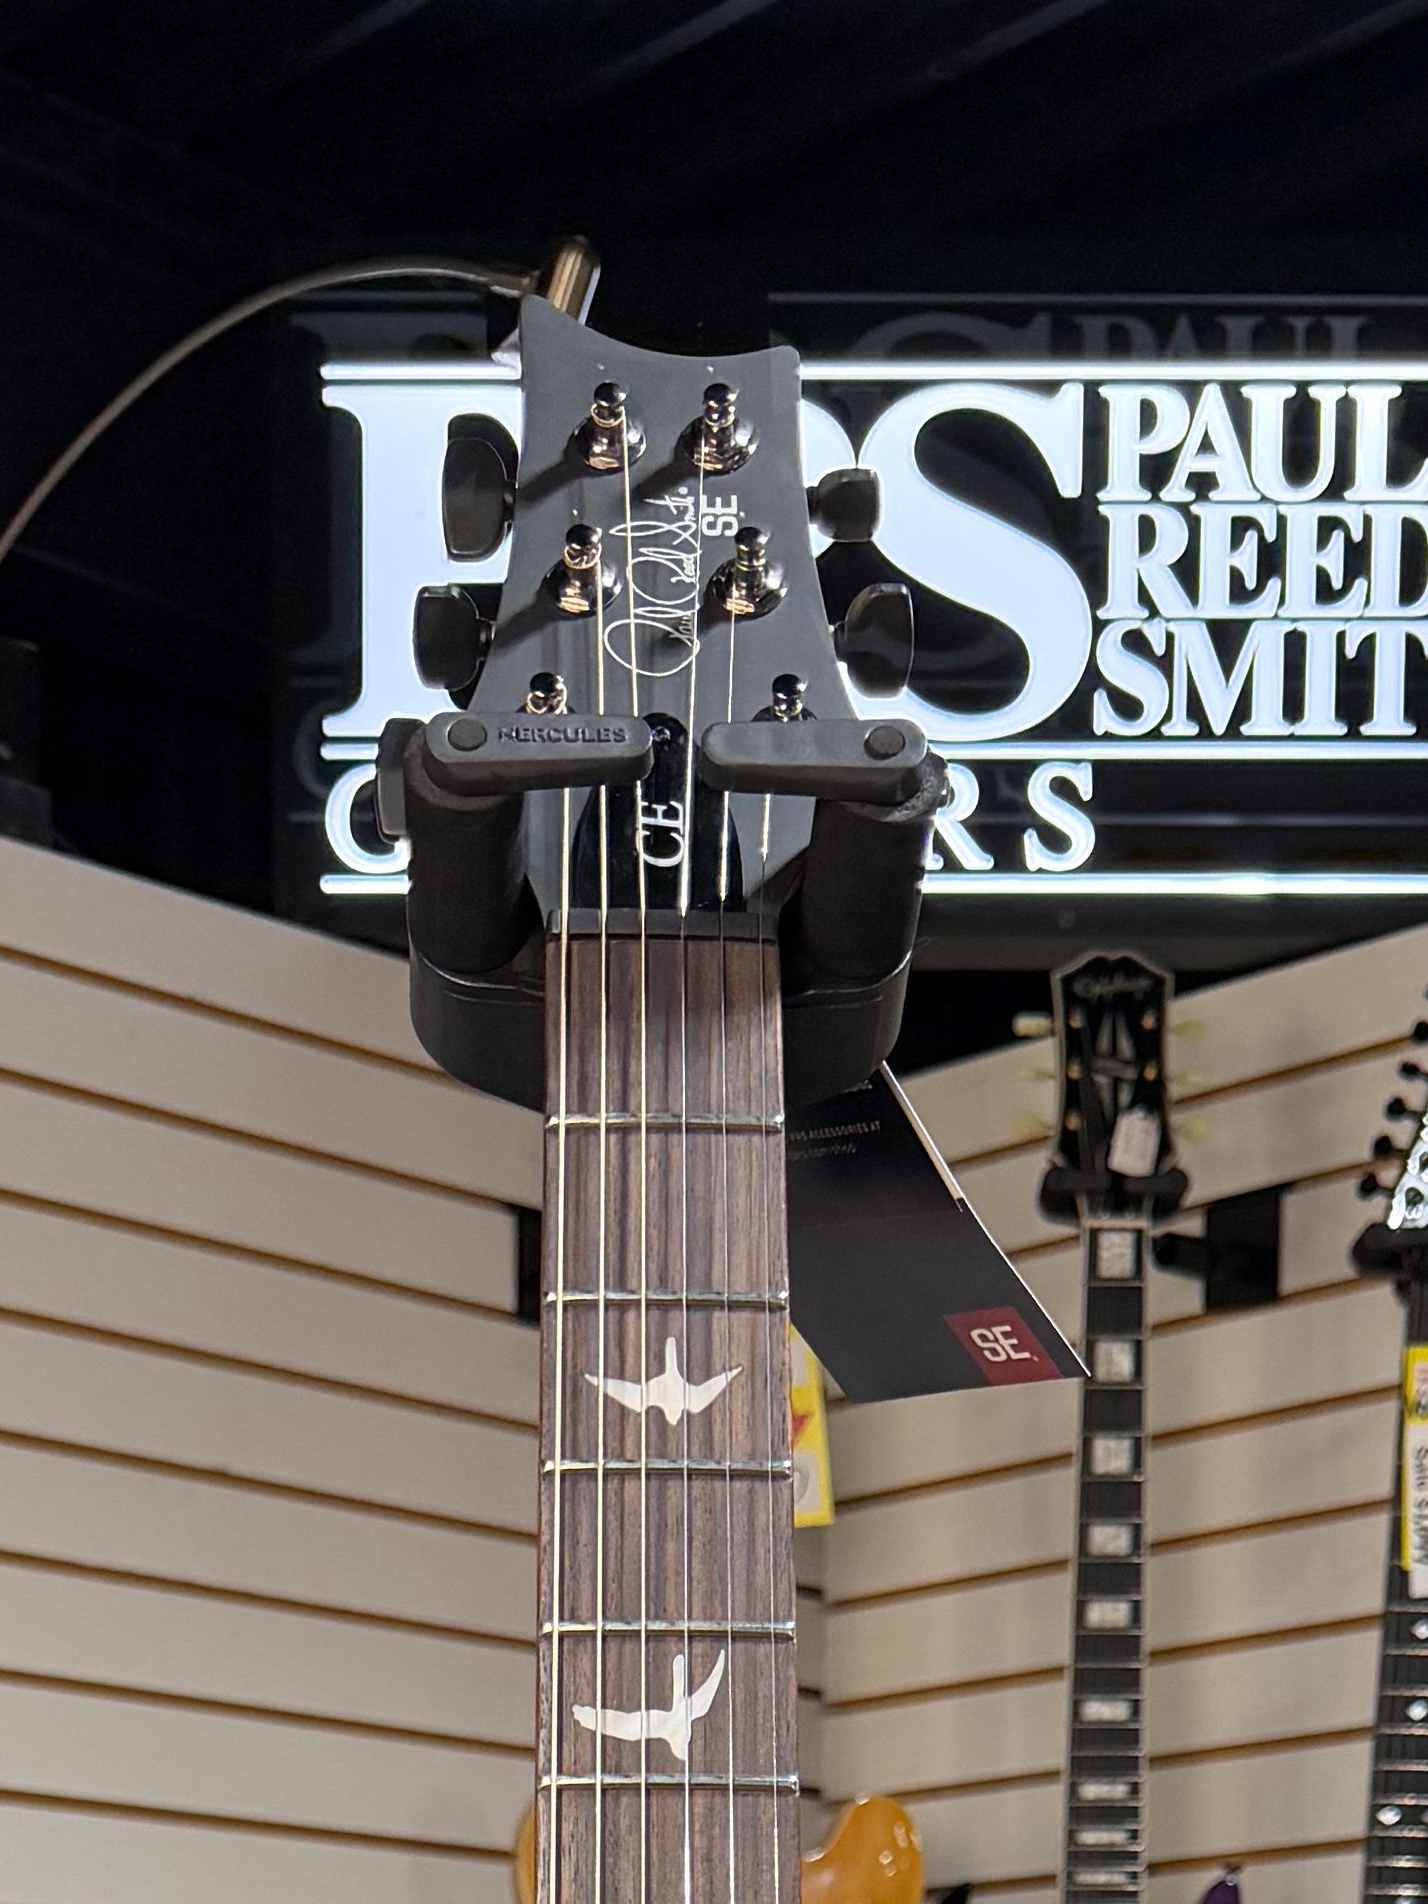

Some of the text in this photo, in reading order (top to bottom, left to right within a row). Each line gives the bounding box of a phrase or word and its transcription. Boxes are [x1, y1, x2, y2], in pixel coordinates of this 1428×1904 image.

[701, 493, 739, 538] SE
[497, 724, 628, 745] HERCULES
[639, 799, 685, 868] CE
[971, 1323, 1032, 1366] SE
